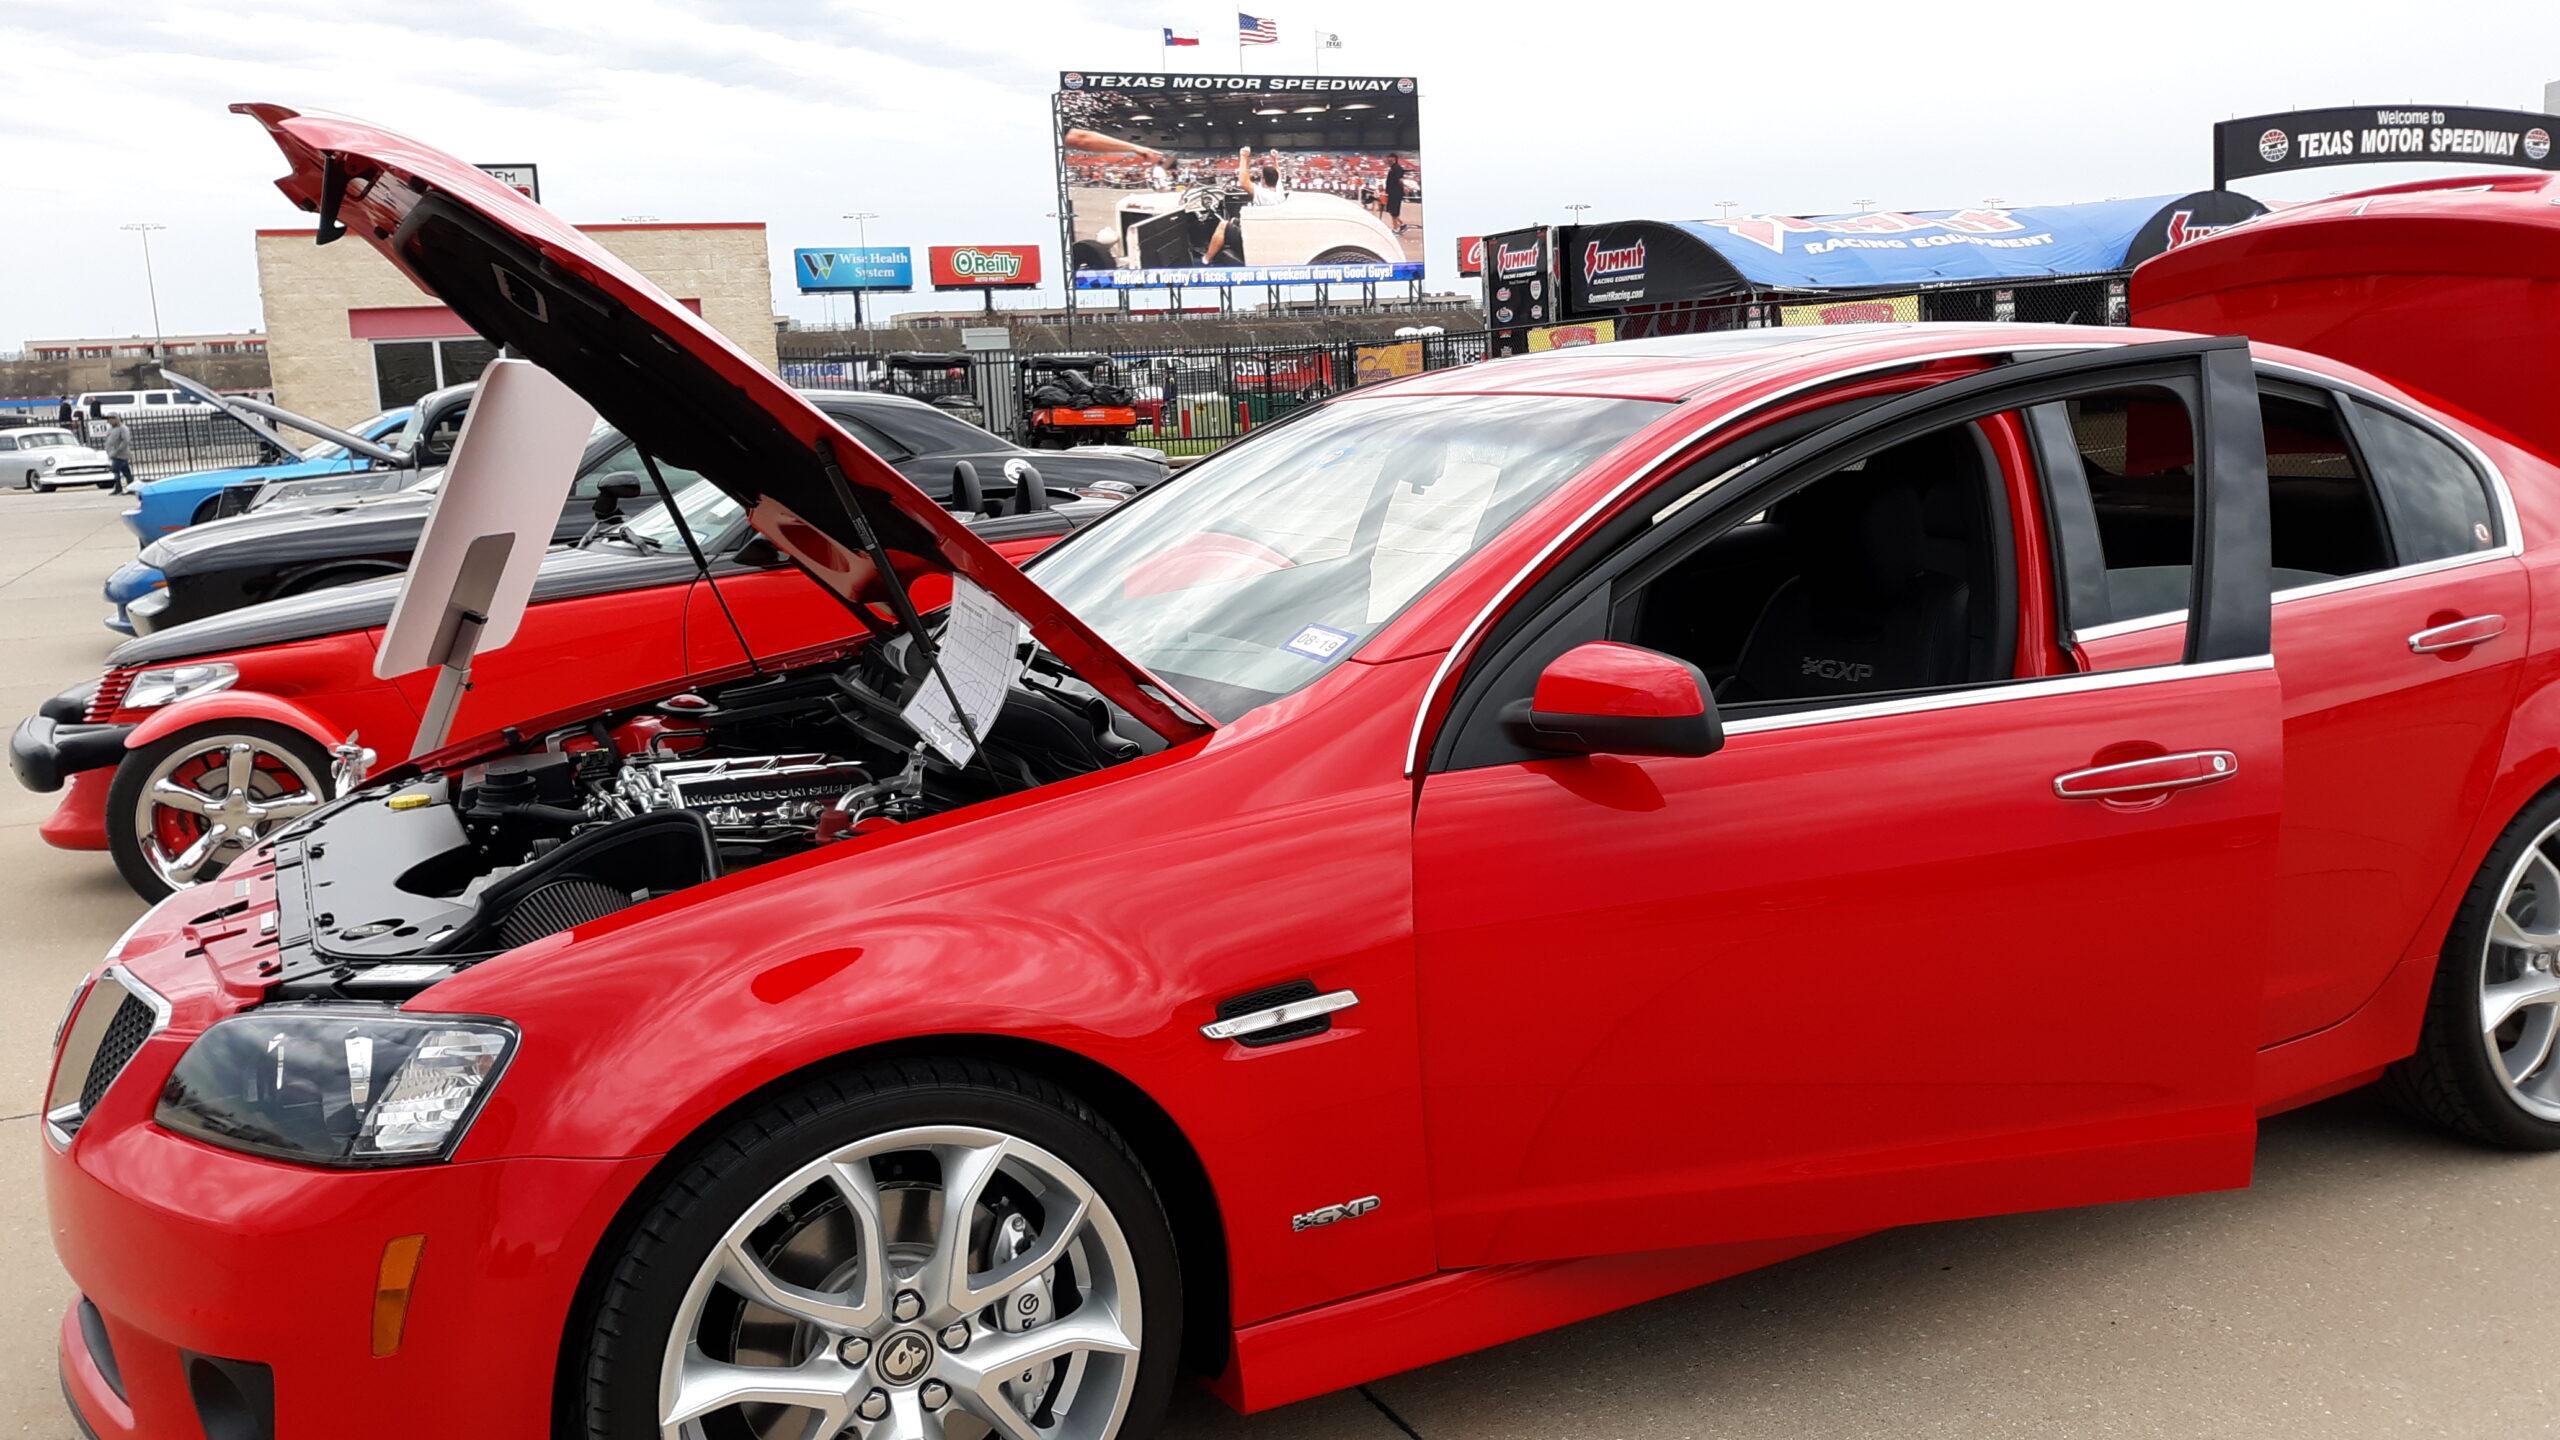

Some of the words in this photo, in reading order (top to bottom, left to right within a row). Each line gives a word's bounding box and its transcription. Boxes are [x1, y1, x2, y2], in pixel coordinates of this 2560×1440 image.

[1086, 75, 1166, 88] TEXAS
[1172, 77, 1262, 90] MOTOR
[1269, 78, 1394, 91] SPEEDWAY
[2376, 110, 2430, 126] Welcome
[2431, 110, 2446, 125] to
[2297, 129, 2354, 158] TEXAS
[2361, 127, 2425, 153] MOTOR
[2429, 128, 2521, 157] SPEEDWAY
[1803, 234, 1909, 255] RACING
[1913, 232, 2055, 250] EQUIPMENT
[839, 253, 868, 264] Wise
[870, 252, 909, 264] Health
[954, 249, 1019, 276] O'Reilly
[855, 267, 895, 280] System
[1113, 270, 1145, 285] Refuel
[1148, 272, 1157, 284] at
[1160, 270, 1199, 286] Torchy's
[1231, 272, 1255, 285] open
[1256, 268, 1267, 281] all
[1269, 267, 1311, 281] weekend
[1313, 265, 1343, 281] during
[1344, 265, 1366, 279] Good
[1368, 263, 1393, 280] Guys!
[1593, 277, 1614, 286] RACING
[1615, 273, 1645, 283] EQUIPMENT
[1588, 289, 1645, 304] SummitRacing.com
[1819, 659, 1873, 682] GXP
[684, 786, 806, 807] MAGNUSON
